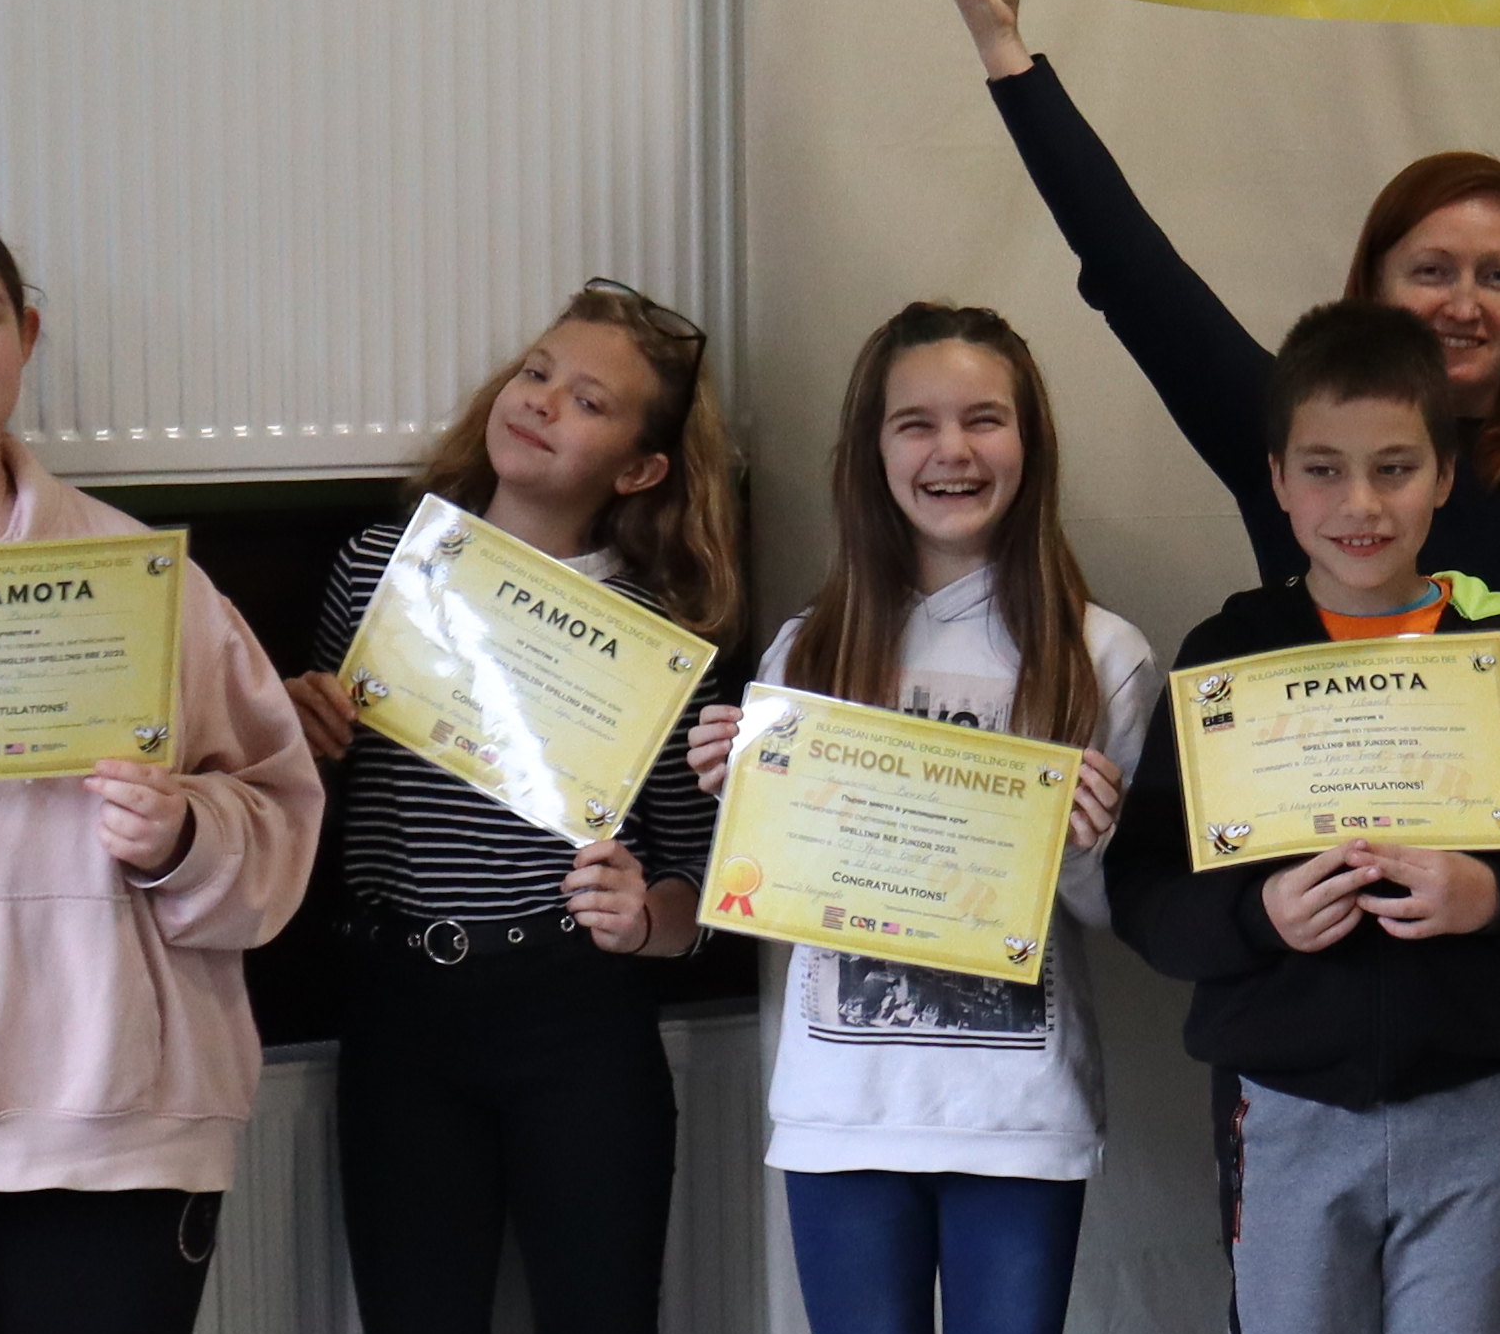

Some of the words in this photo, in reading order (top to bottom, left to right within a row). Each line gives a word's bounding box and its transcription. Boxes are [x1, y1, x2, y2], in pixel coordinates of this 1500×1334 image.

[494, 577, 624, 661] ГРАМОТА
[1286, 673, 1426, 700] ГРАМОТА
[807, 738, 913, 778] SCHOOL
[918, 759, 1027, 800] WINNER
[830, 870, 947, 903] CONGRATULATIONS!
